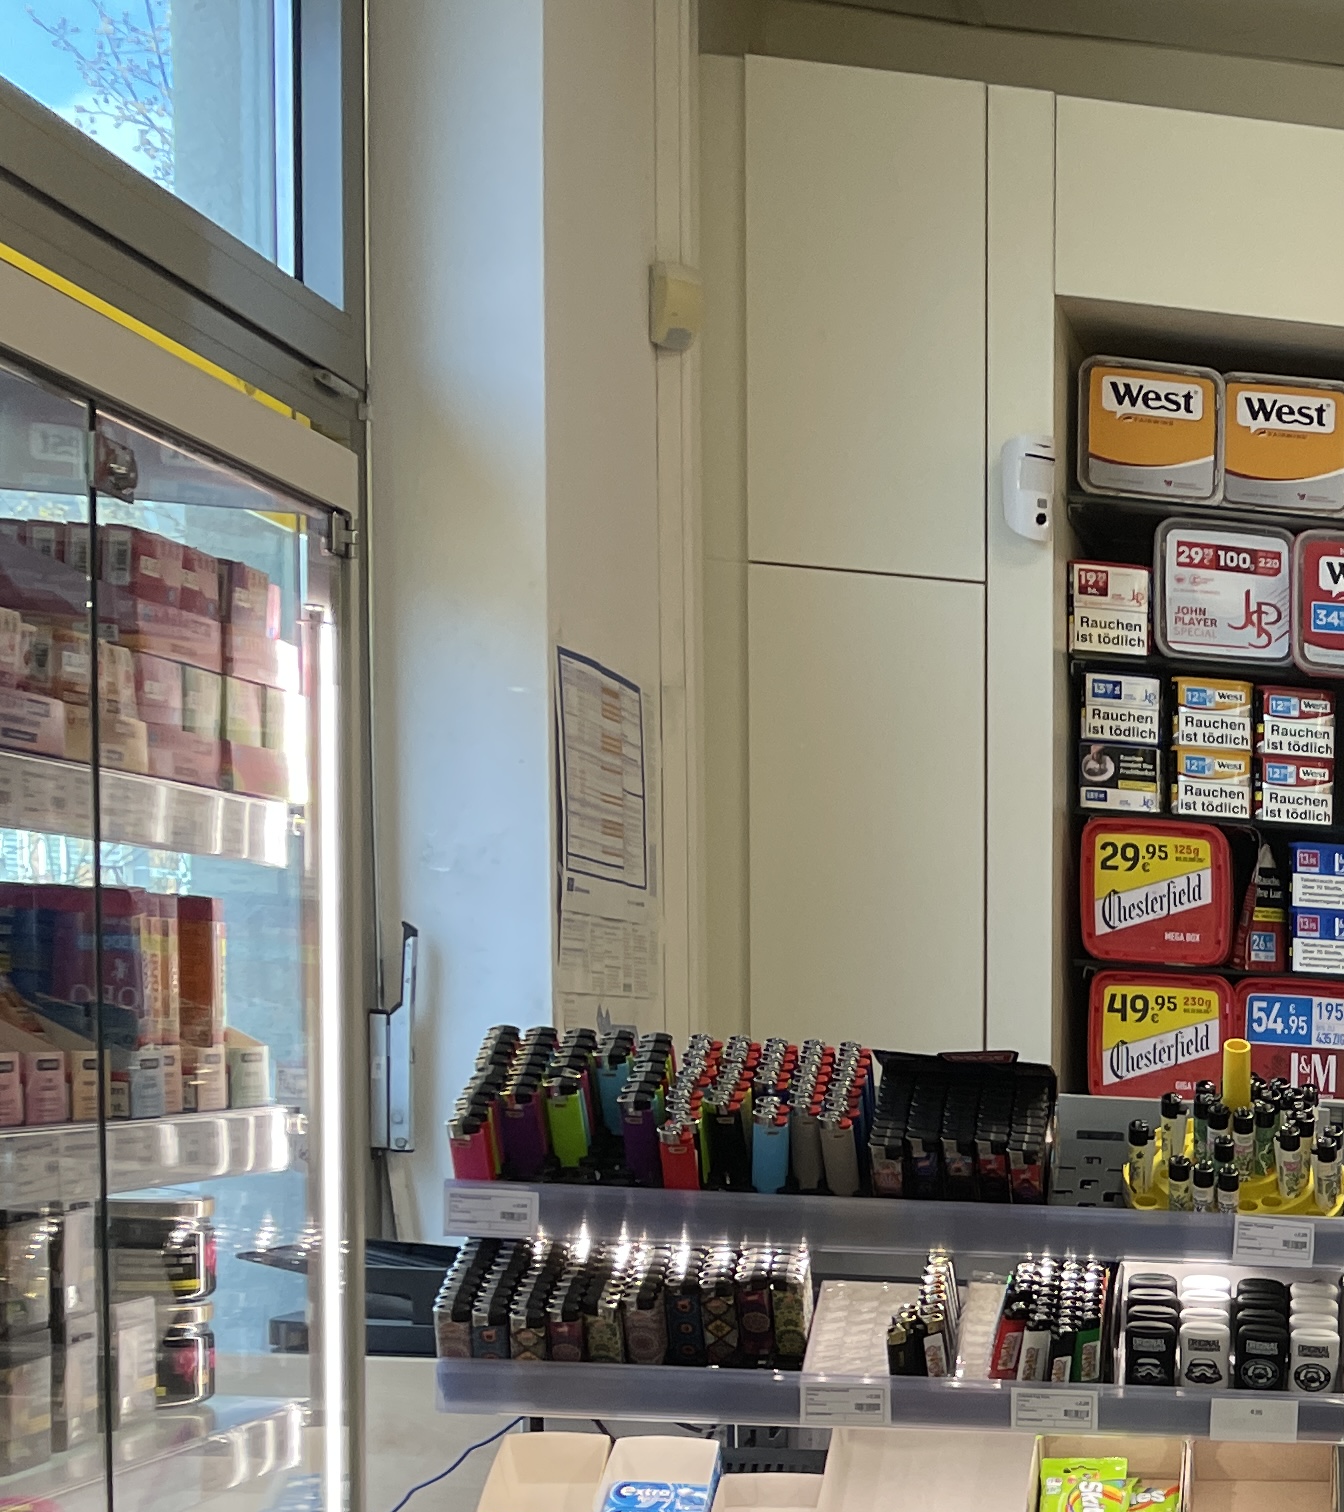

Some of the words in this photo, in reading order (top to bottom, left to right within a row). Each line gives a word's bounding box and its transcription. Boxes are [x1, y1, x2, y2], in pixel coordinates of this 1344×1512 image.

[1110, 381, 1194, 414] West
[1245, 396, 1328, 427] West
[1174, 606, 1207, 617] JOHN
[1081, 616, 1142, 632] Rauchen
[1174, 616, 1218, 627] PLAYER
[1076, 630, 1095, 644] ist
[1097, 632, 1145, 648] tödlich
[1174, 627, 1217, 638] SPECIAL
[1088, 723, 1106, 736] ist
[1109, 725, 1156, 741] tödlich
[1174, 844, 1200, 857] 125g
[1102, 873, 1202, 929] Chesterfield
[1109, 1024, 1210, 1080] Chesterfield
[1290, 1052, 1337, 1093] L&M
[620, 1485, 671, 1498] extra
